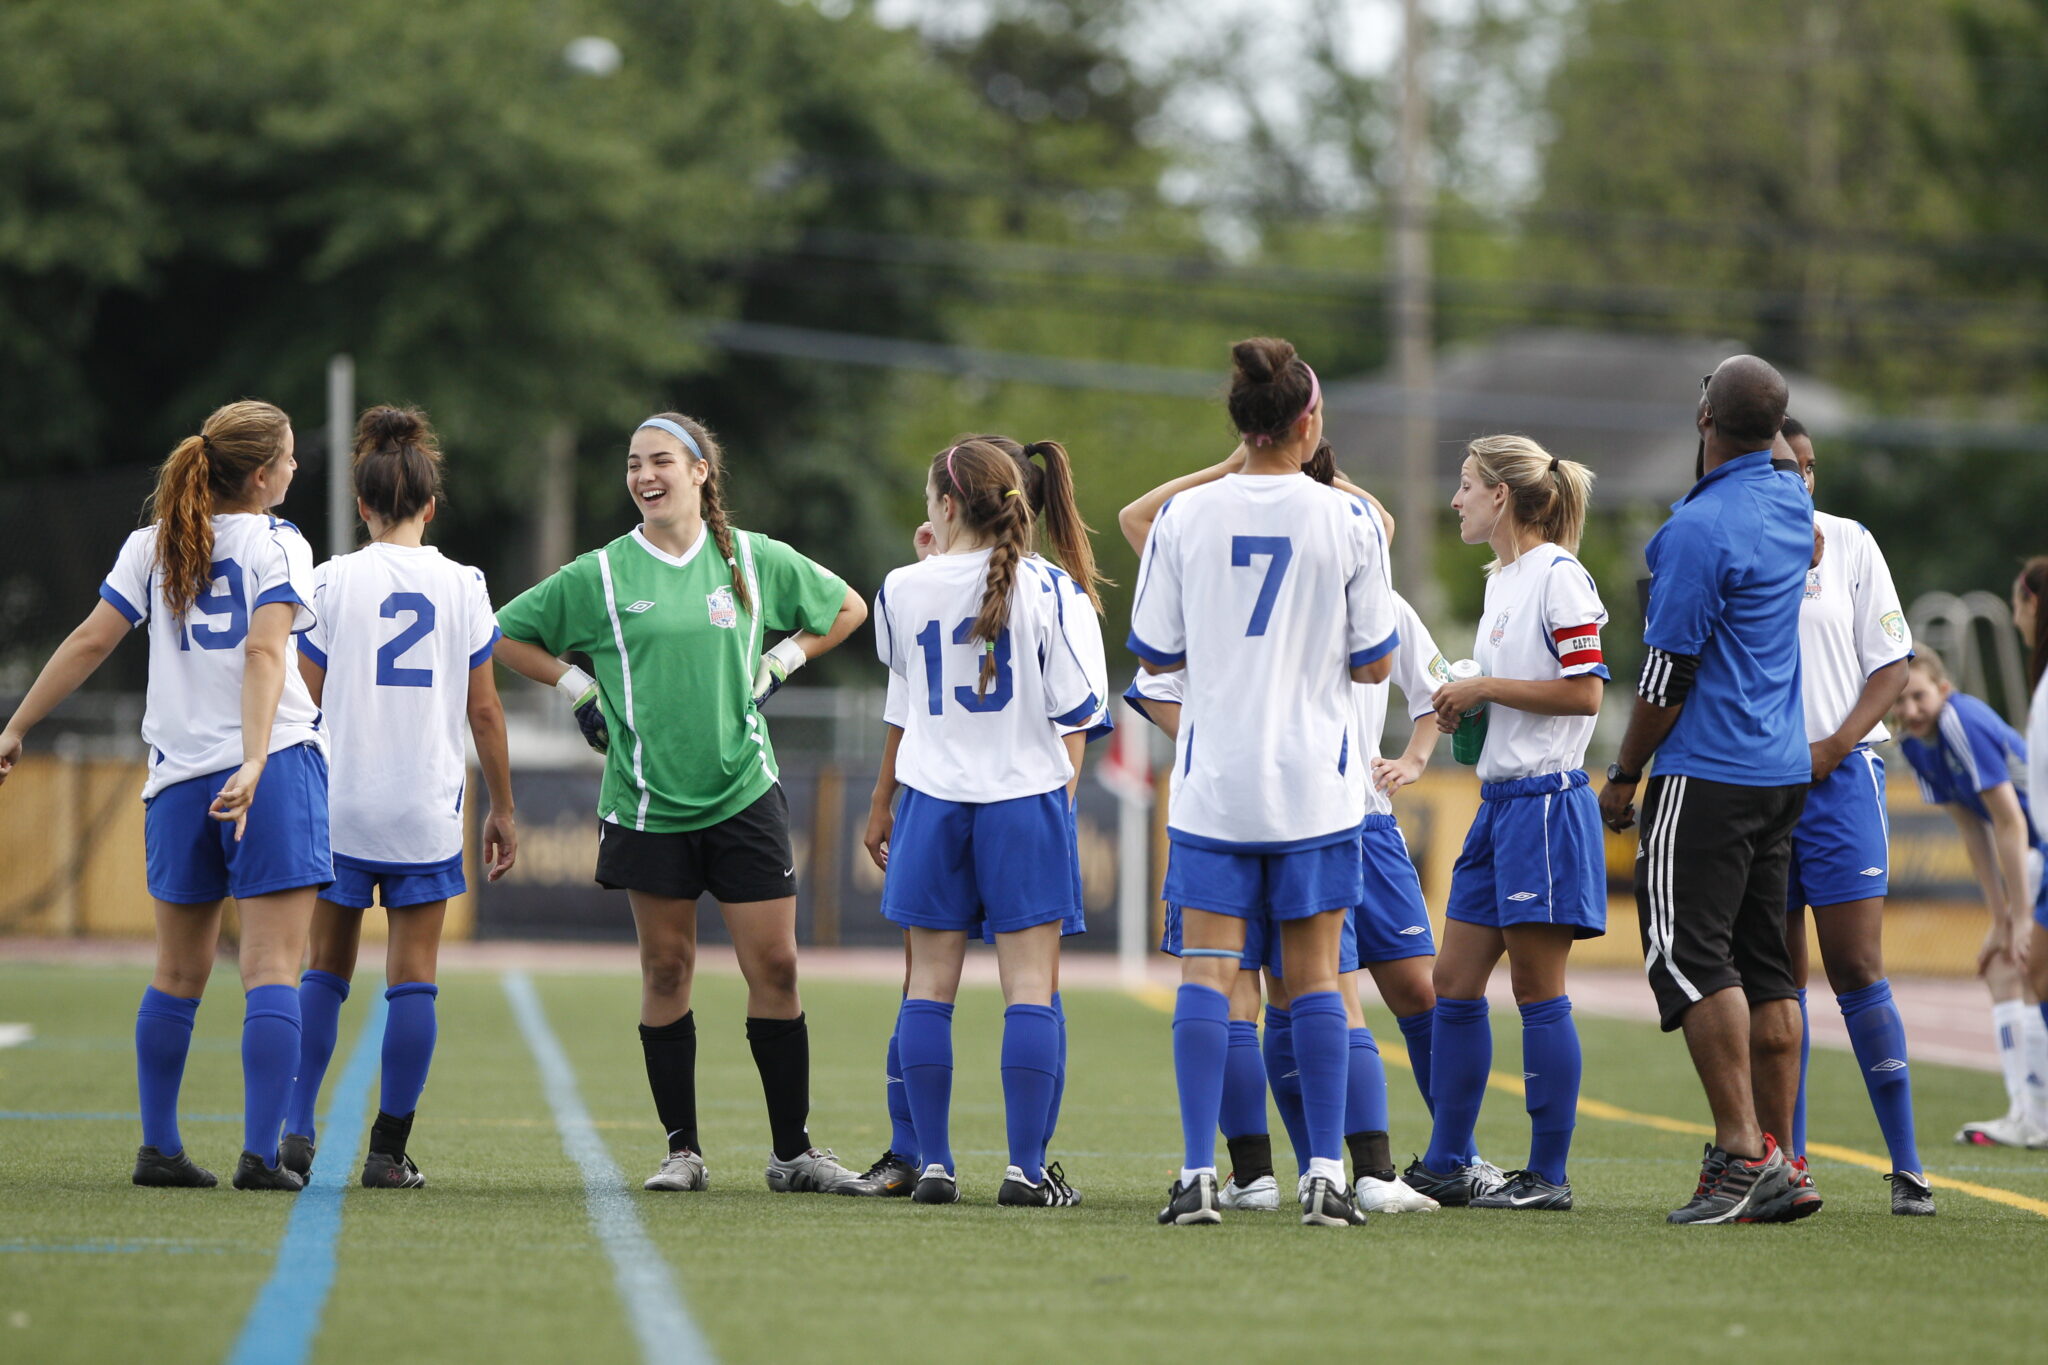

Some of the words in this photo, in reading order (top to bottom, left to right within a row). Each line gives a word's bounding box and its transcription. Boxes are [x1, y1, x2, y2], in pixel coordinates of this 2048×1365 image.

[1231, 535, 1294, 638] 7
[376, 591, 436, 688] 2
[916, 616, 1014, 716] 13
